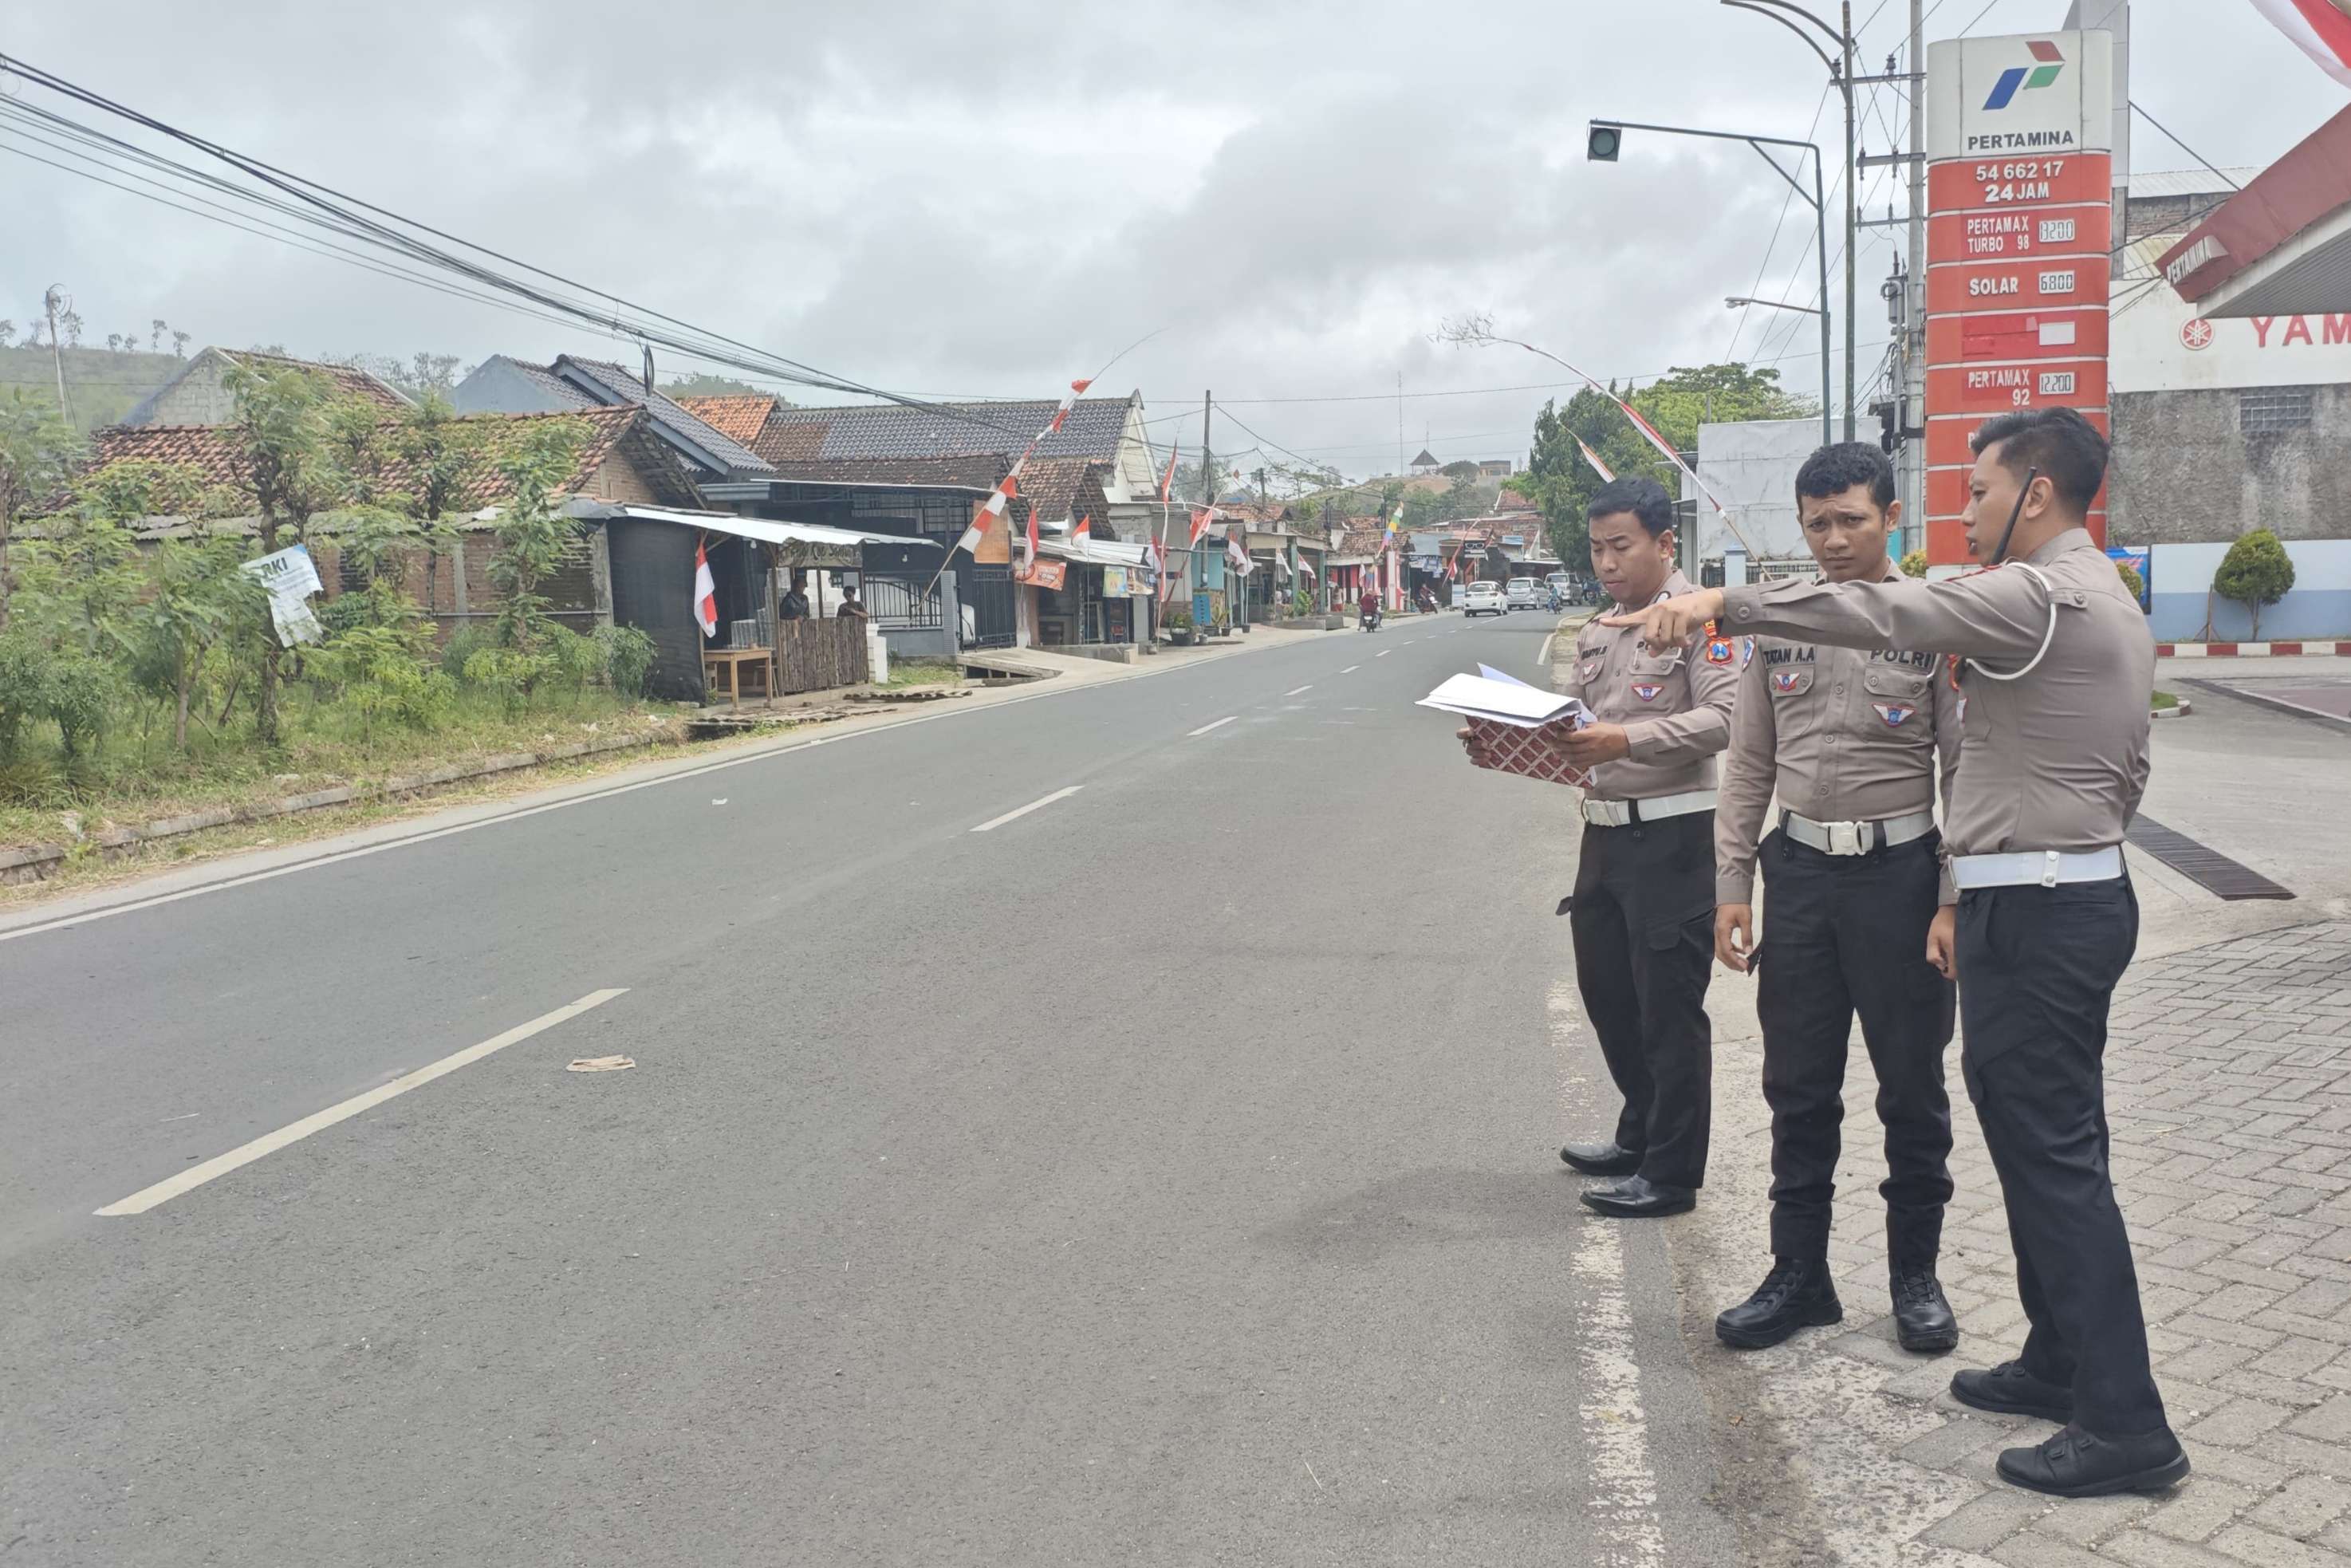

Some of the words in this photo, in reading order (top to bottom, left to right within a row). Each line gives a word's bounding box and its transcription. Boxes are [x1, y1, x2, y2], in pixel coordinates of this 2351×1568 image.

[1968, 131, 2073, 150] PERTAMINA
[1976, 165, 1999, 181] 54
[2003, 162, 2038, 179] 662
[2043, 160, 2064, 177] 17
[1985, 183, 2014, 203] 24
[2016, 182, 2050, 199] JAM
[1967, 215, 2029, 235] PERTAMAX
[1967, 236, 2004, 253] TURBO
[2017, 234, 2030, 250] 98
[1970, 277, 2019, 296] SOLAR
[2041, 274, 2073, 291] 6800
[1968, 368, 2030, 388] PERTAMAX
[2012, 388, 2030, 406] 92
[1795, 647, 1815, 662] A.A
[1870, 650, 1931, 668] POLRI
